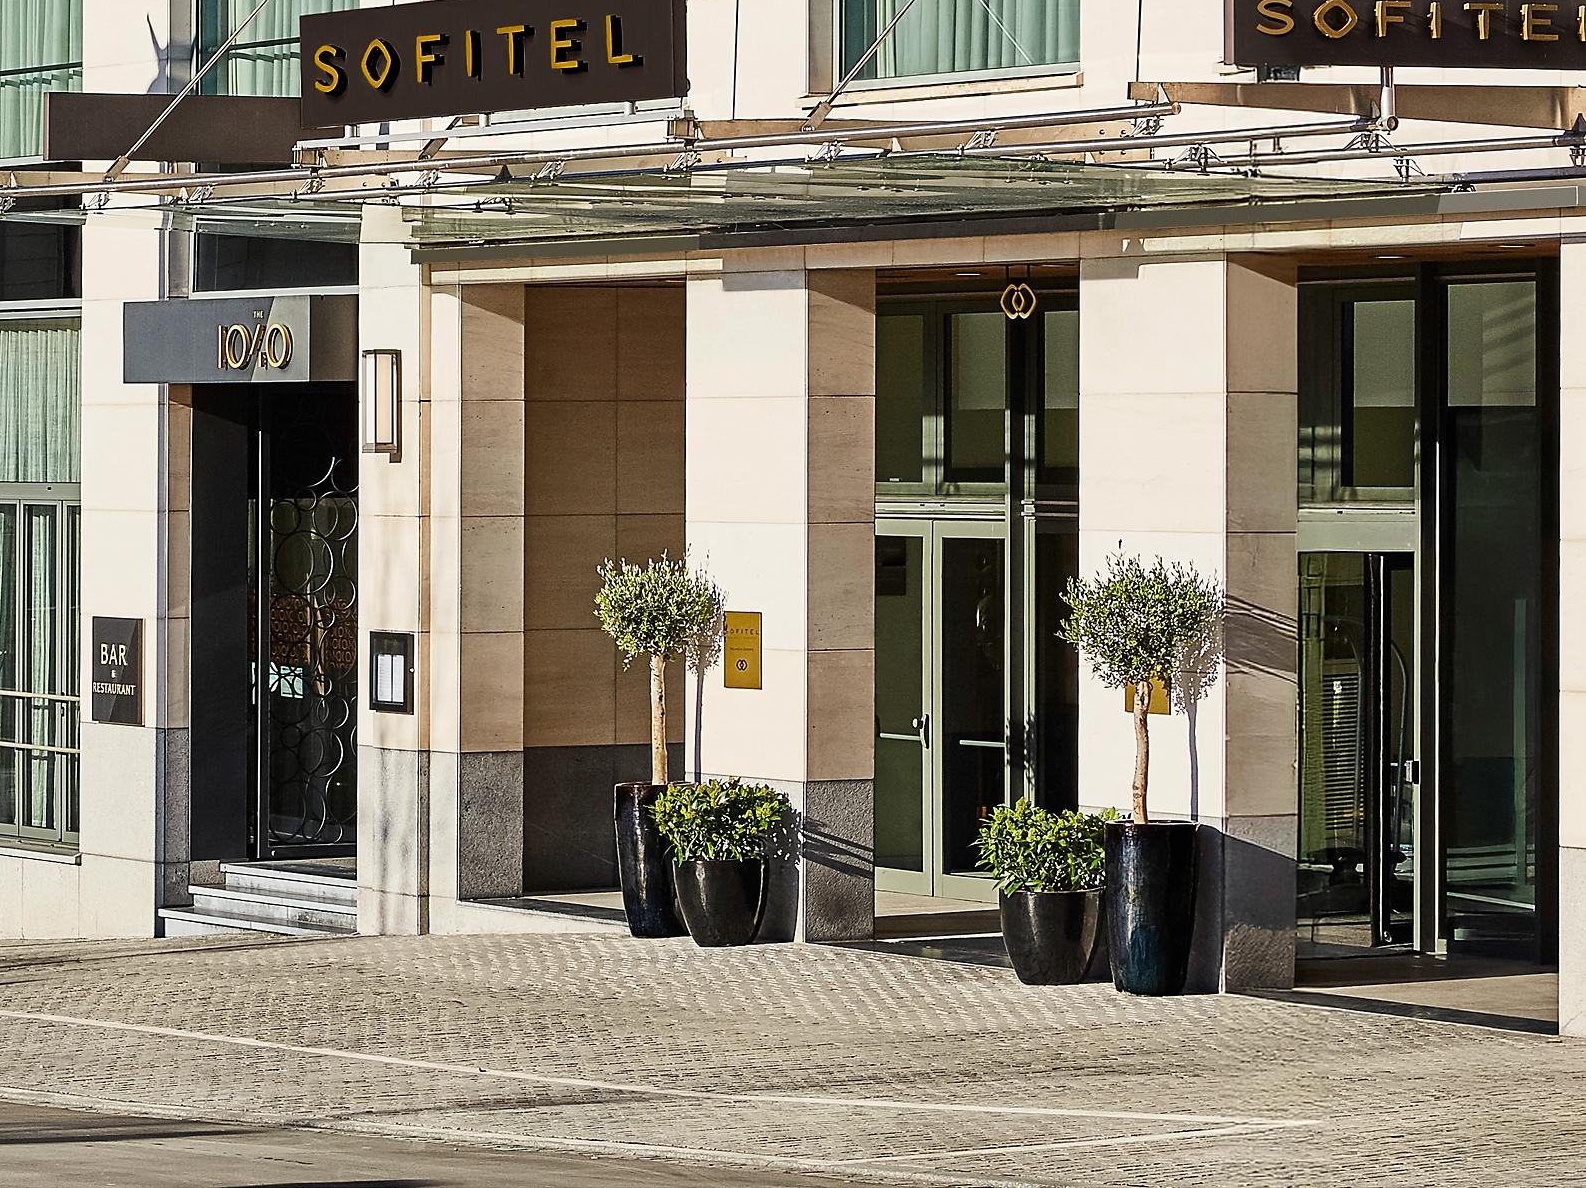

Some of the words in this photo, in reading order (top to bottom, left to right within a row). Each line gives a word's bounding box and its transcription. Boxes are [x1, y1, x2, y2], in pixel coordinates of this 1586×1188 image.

[314, 14, 644, 96] SOFITEL
[253, 310, 264, 319] THE
[100, 643, 128, 666] BAR
[93, 682, 136, 696] RESTAURANT
